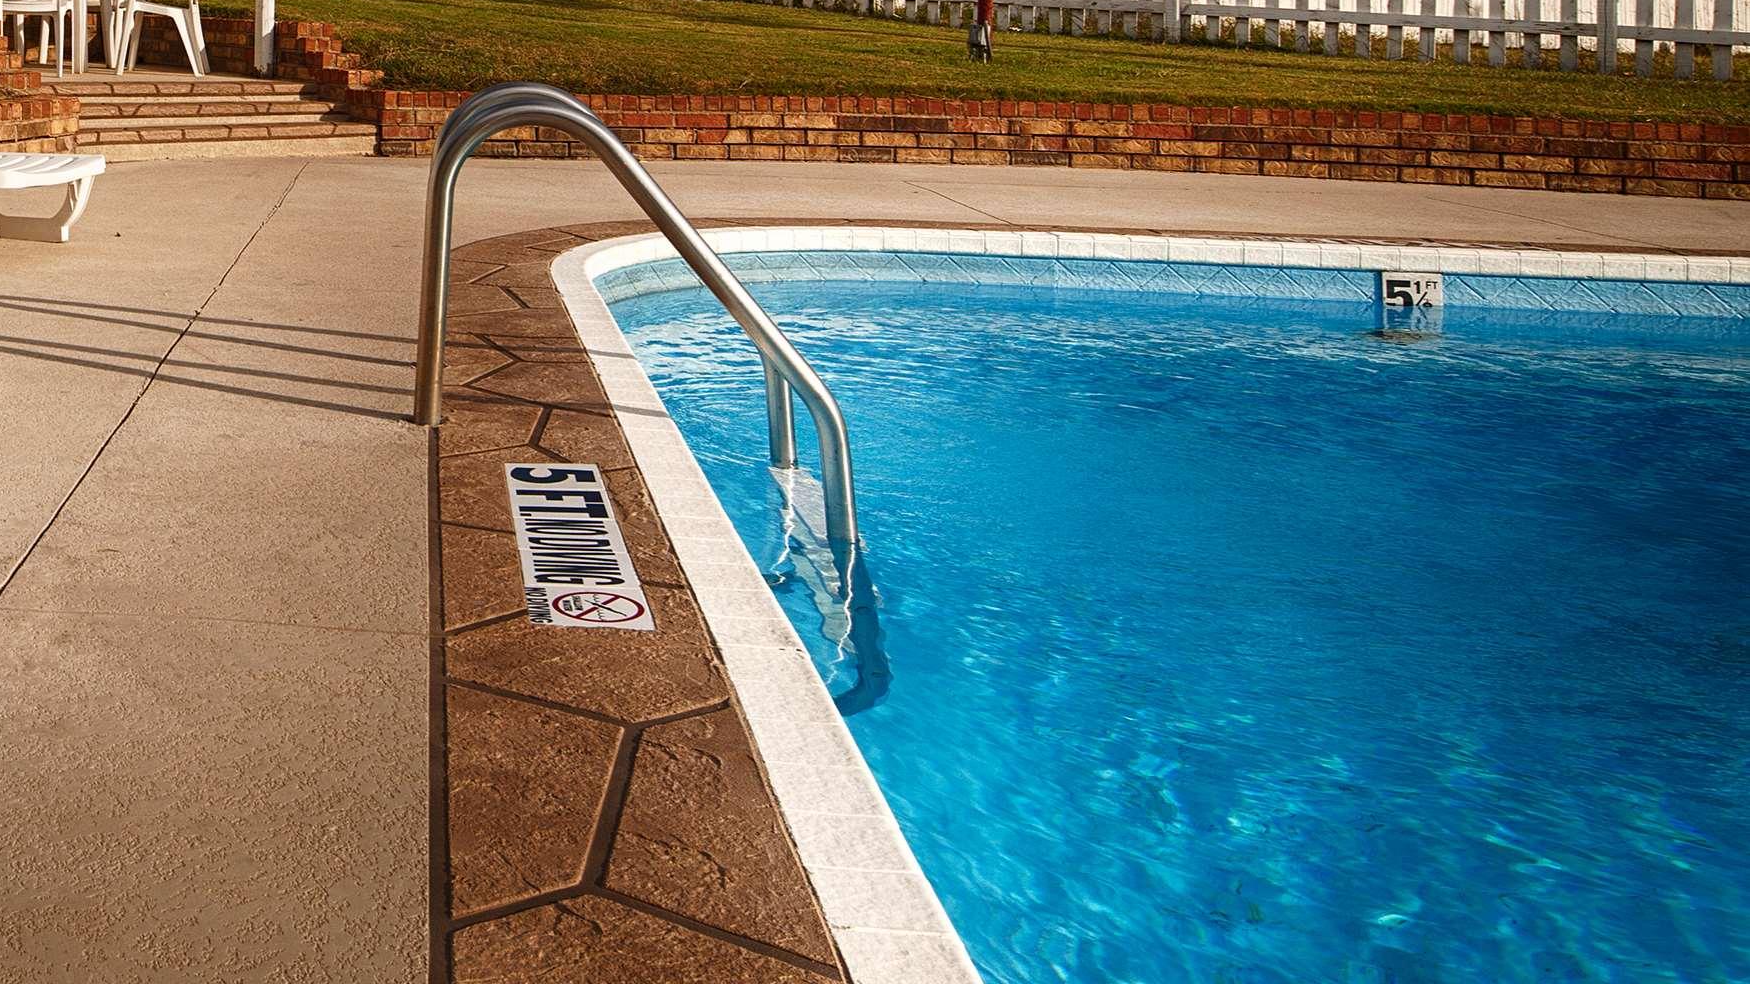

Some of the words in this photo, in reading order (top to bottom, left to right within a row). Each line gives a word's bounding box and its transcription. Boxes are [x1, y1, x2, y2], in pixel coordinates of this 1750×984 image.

[1425, 281, 1439, 290] FT
[510, 467, 597, 484] 5
[524, 518, 609, 536] NO
[528, 537, 625, 586] DIVING
[524, 587, 547, 597] NO
[526, 598, 553, 623] DIVING
